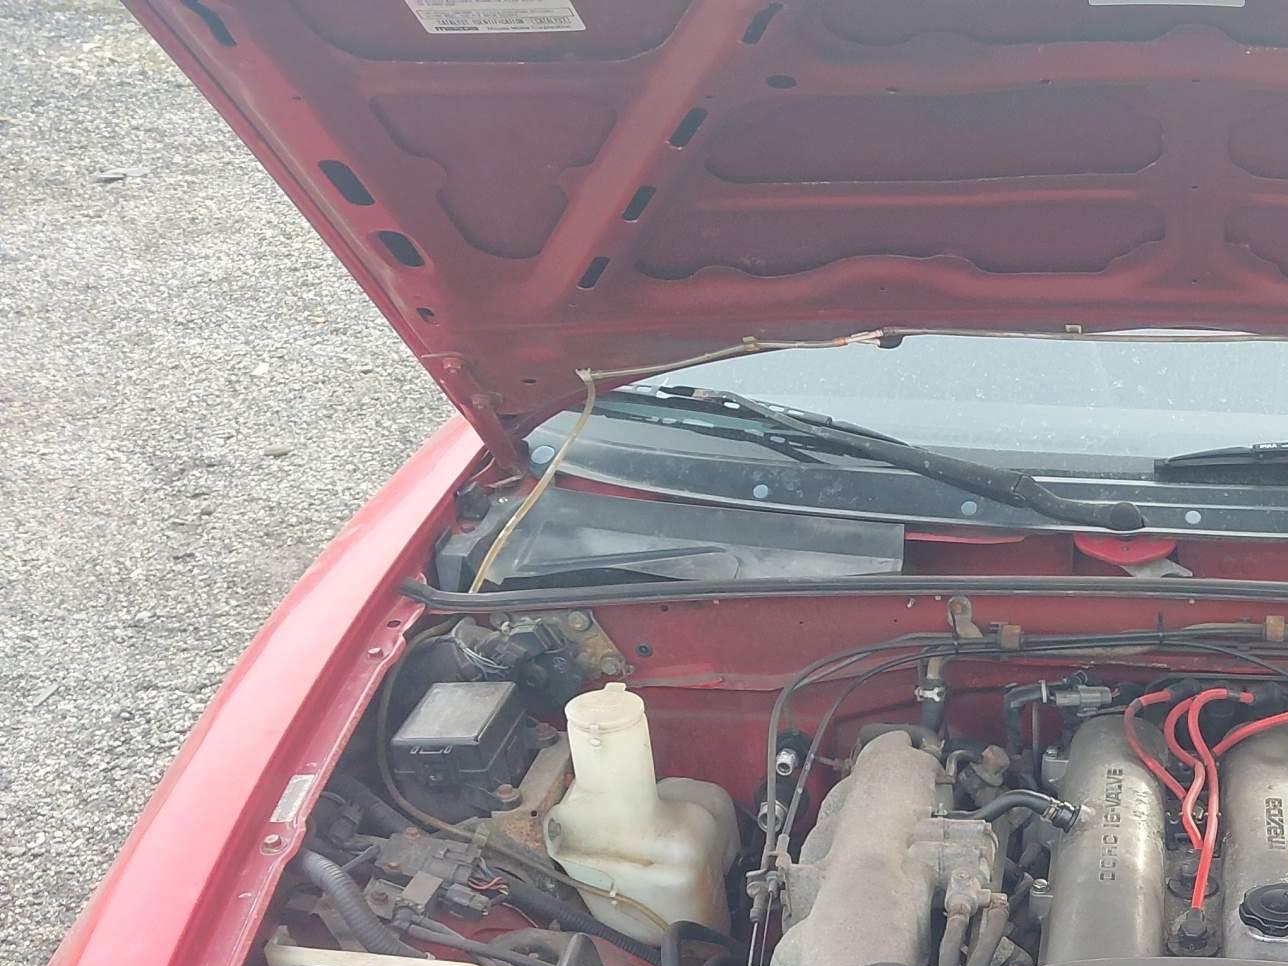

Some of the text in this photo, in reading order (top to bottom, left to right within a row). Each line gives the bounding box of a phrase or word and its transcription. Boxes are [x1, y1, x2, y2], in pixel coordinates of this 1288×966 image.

[1100, 768, 1124, 881] DOHC 16-VALVE
[1264, 797, 1286, 850] mazda
